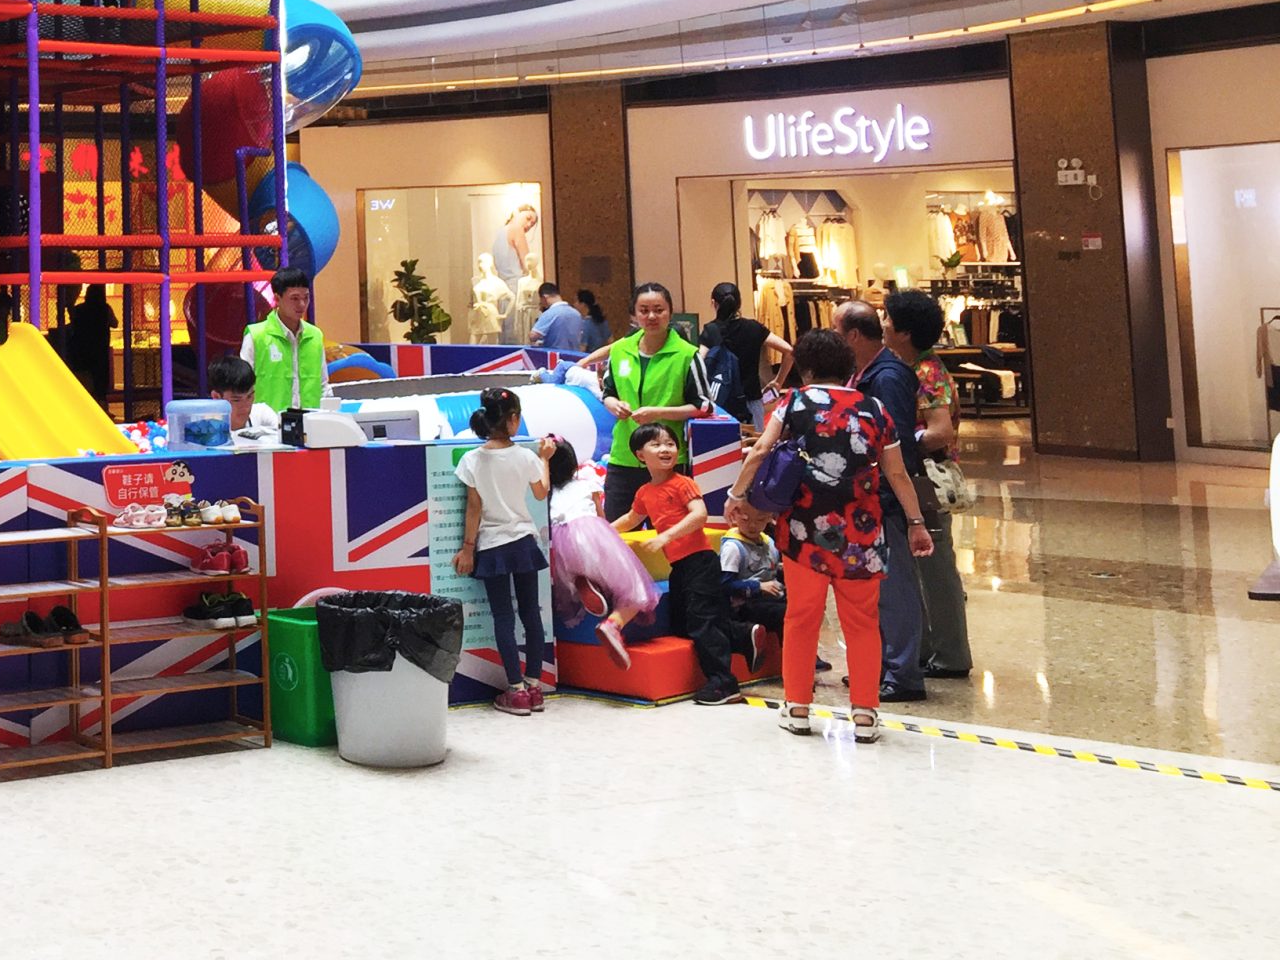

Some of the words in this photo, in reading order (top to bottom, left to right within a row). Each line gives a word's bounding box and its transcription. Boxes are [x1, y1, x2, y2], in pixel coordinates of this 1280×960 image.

[744, 103, 930, 163] UlifeStyle
[122, 473, 154, 486] 鞋子请
[118, 486, 159, 500] 自行保管
